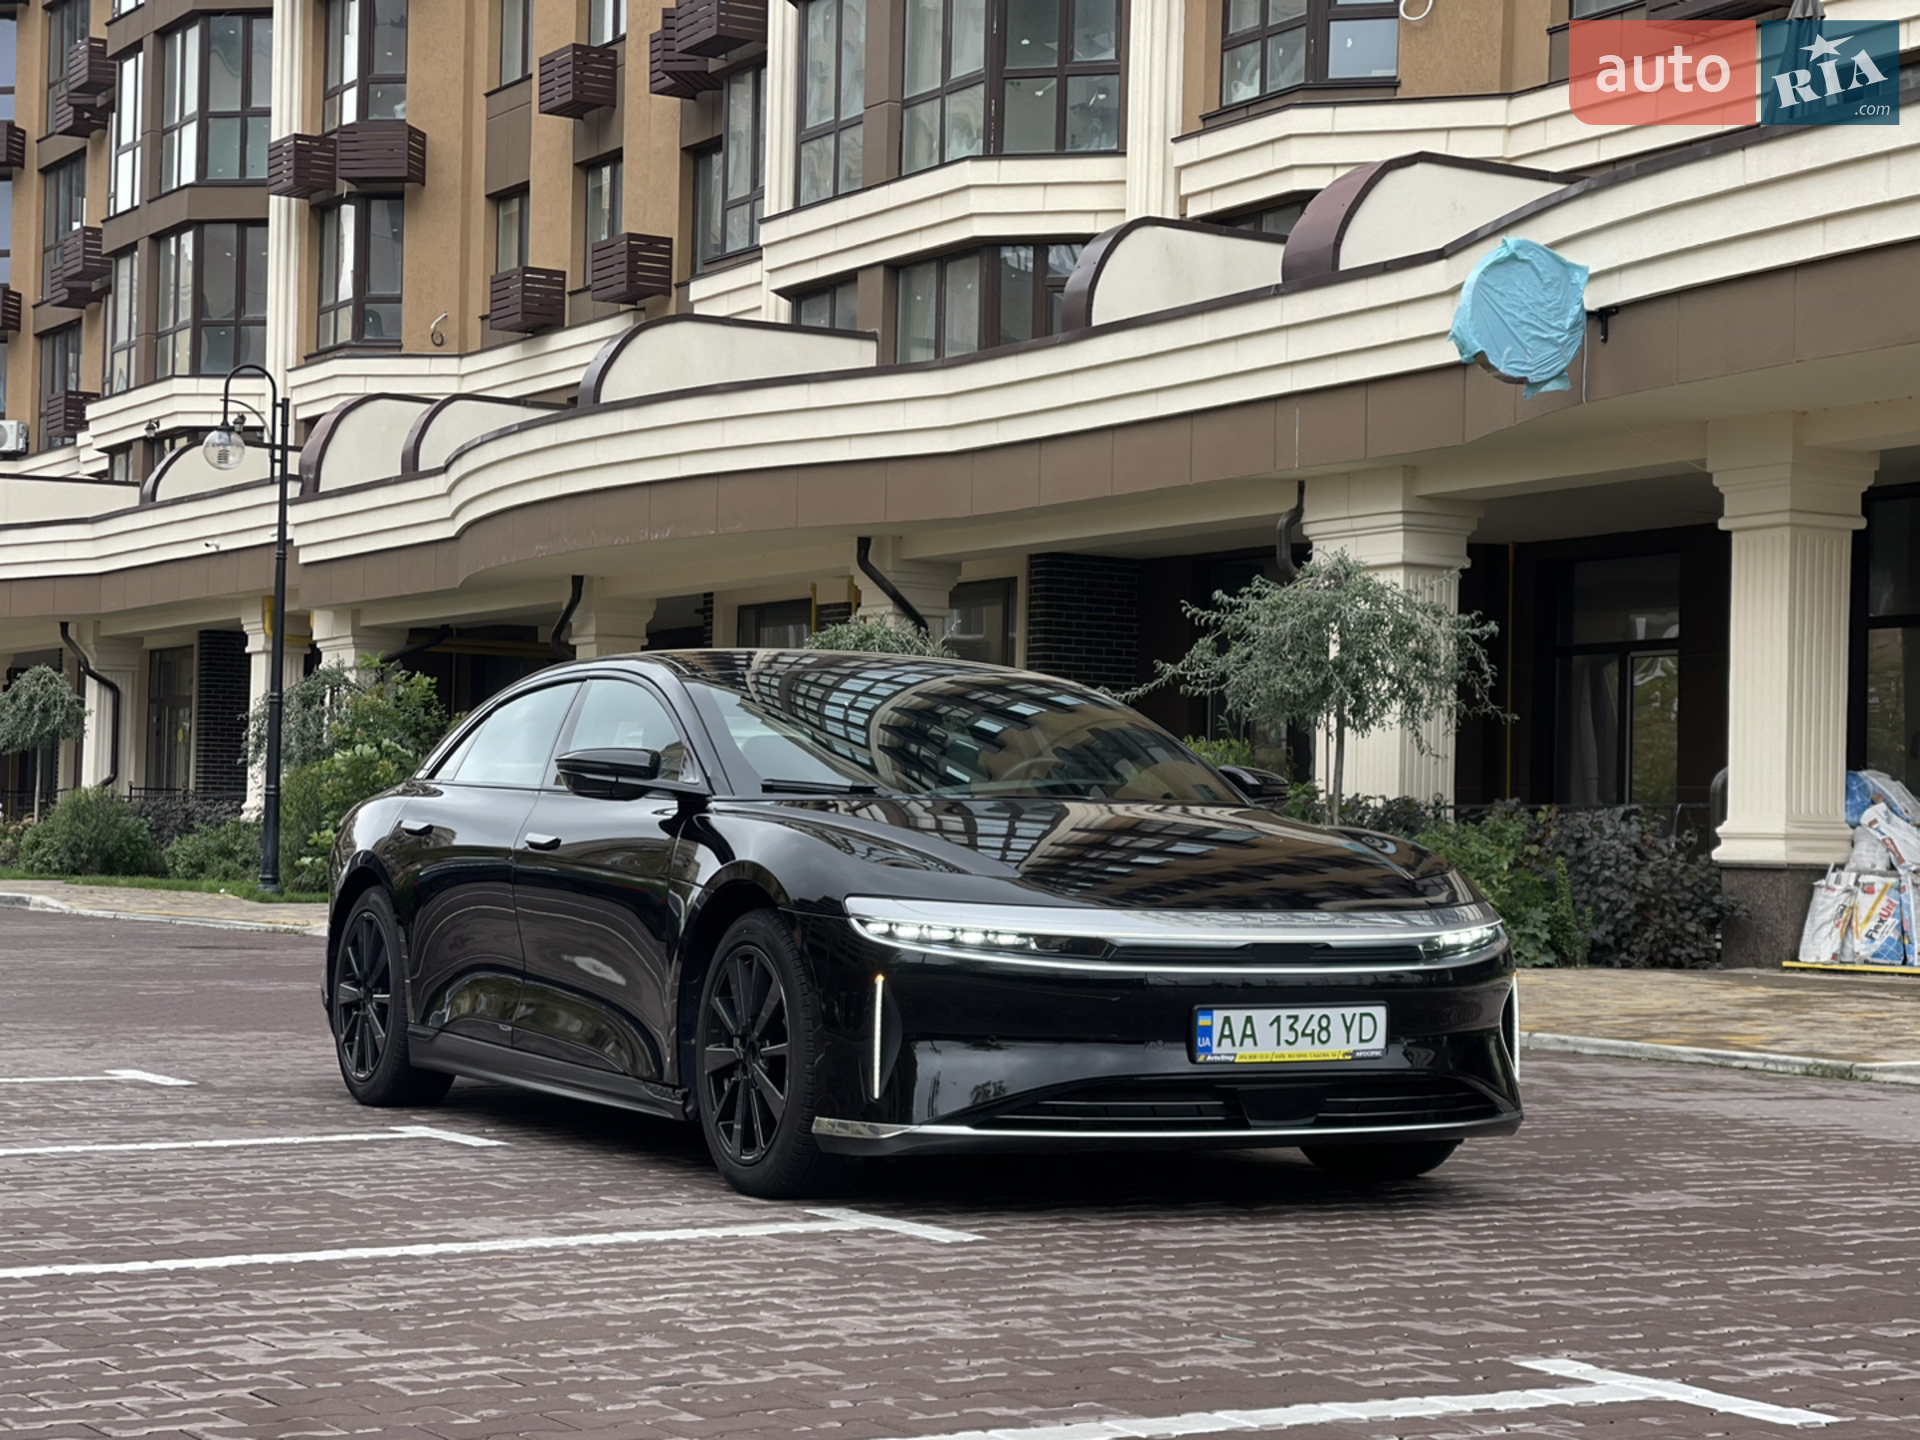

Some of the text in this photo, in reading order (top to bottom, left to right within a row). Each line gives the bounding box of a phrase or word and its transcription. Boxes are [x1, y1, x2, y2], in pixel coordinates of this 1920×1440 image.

[1216, 1012, 1378, 1048] AA 1348 YD
[1198, 1037, 1212, 1048] UA
